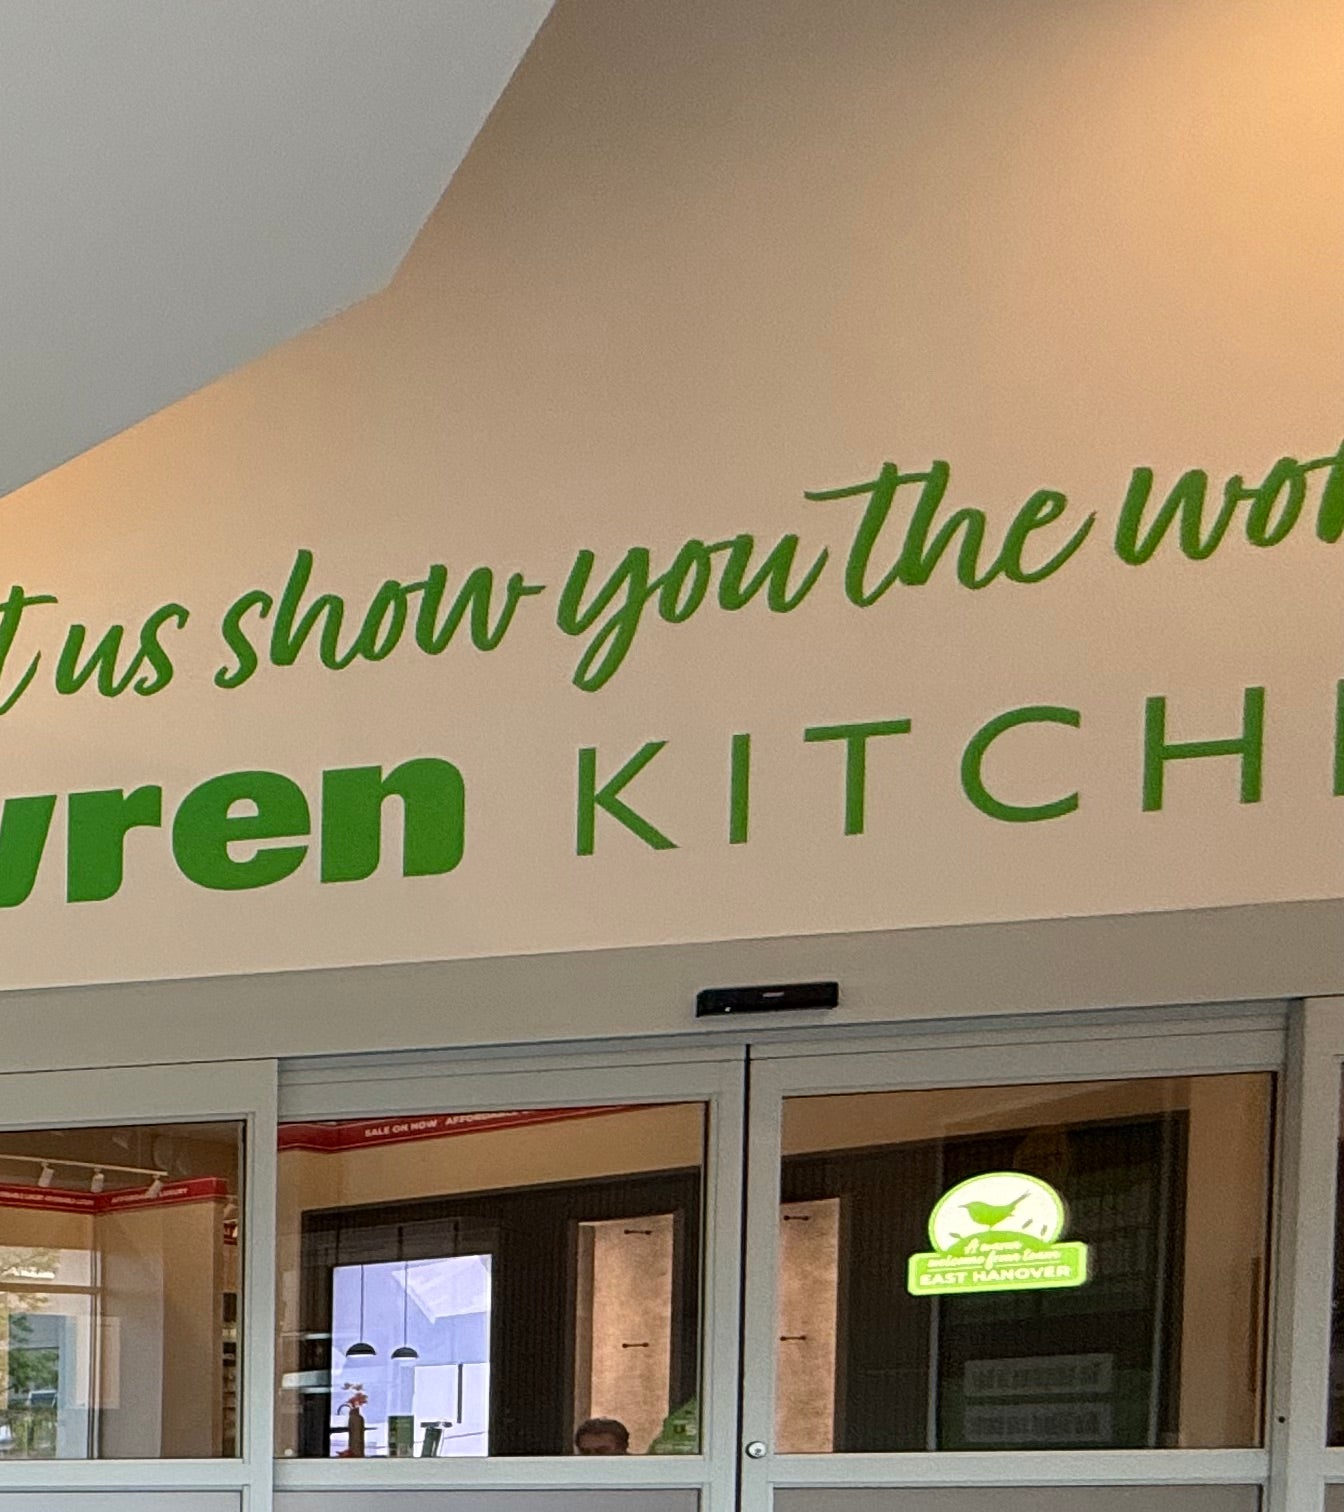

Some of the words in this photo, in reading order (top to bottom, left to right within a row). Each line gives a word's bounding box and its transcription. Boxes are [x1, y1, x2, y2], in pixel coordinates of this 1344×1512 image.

[55, 603, 190, 698] us
[213, 550, 546, 688] show
[557, 533, 829, 692] you
[804, 460, 1098, 608] the
[575, 678, 1344, 856] KITCH
[365, 1126, 390, 1137] SALE
[392, 1123, 409, 1134] ON
[411, 1119, 438, 1130] NOW
[919, 1271, 969, 1286] EAST
[972, 1265, 1073, 1283] HANOVER
